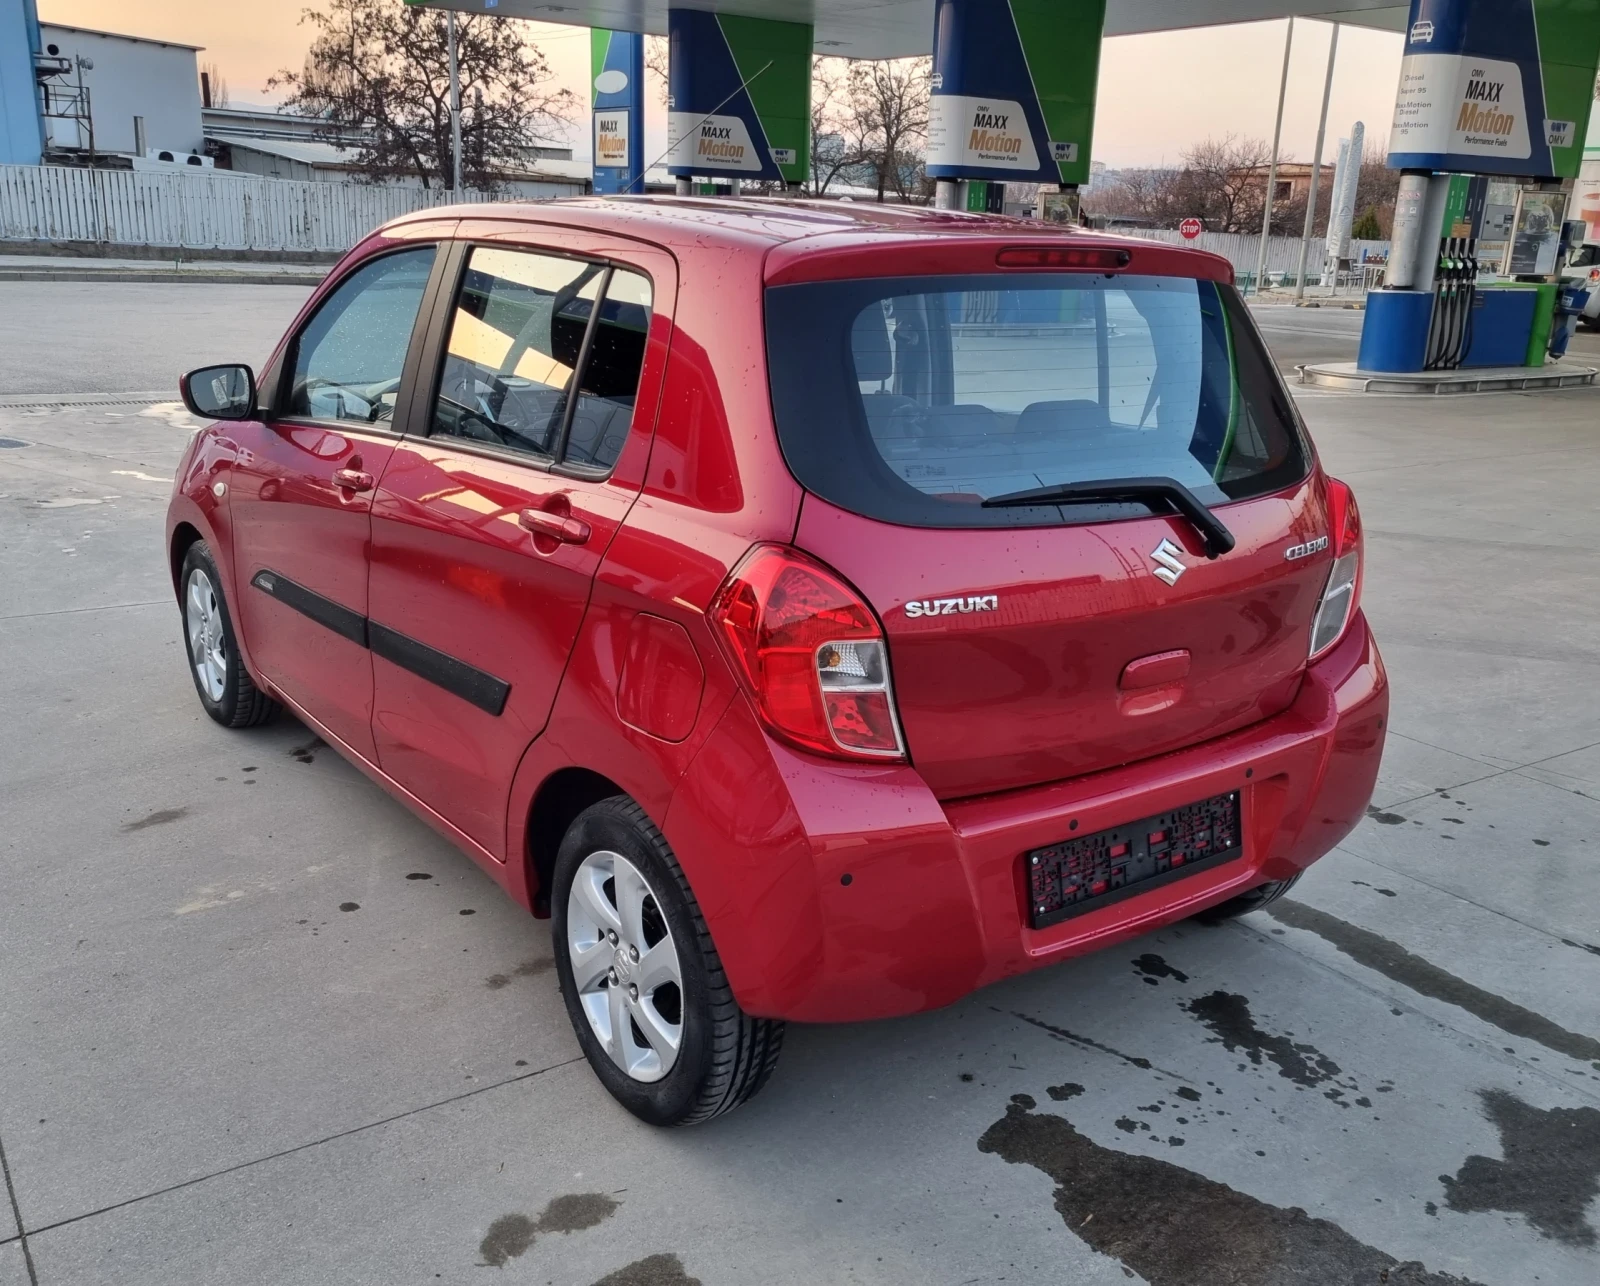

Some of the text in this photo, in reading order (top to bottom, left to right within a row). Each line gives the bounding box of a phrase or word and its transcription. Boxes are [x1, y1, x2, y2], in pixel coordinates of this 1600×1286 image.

[1404, 74, 1424, 82] Diesel
[1471, 68, 1486, 78] OMV
[1464, 80, 1504, 102] MAXX
[600, 120, 618, 132] MAXX
[974, 113, 1008, 130] MAXX
[1456, 102, 1514, 136] Motion
[701, 126, 732, 140] MAXX
[1548, 134, 1566, 144] OMV
[598, 134, 626, 152] Motion
[698, 138, 744, 158] Motion
[968, 129, 1022, 154] Motion
[1464, 136, 1508, 146] Performance Fuels
[978, 153, 1006, 161] Performance
[1054, 152, 1070, 160] OMV
[1182, 225, 1198, 233] STOP
[1286, 536, 1328, 560] CELERIO
[904, 595, 998, 618] SUZUKI
